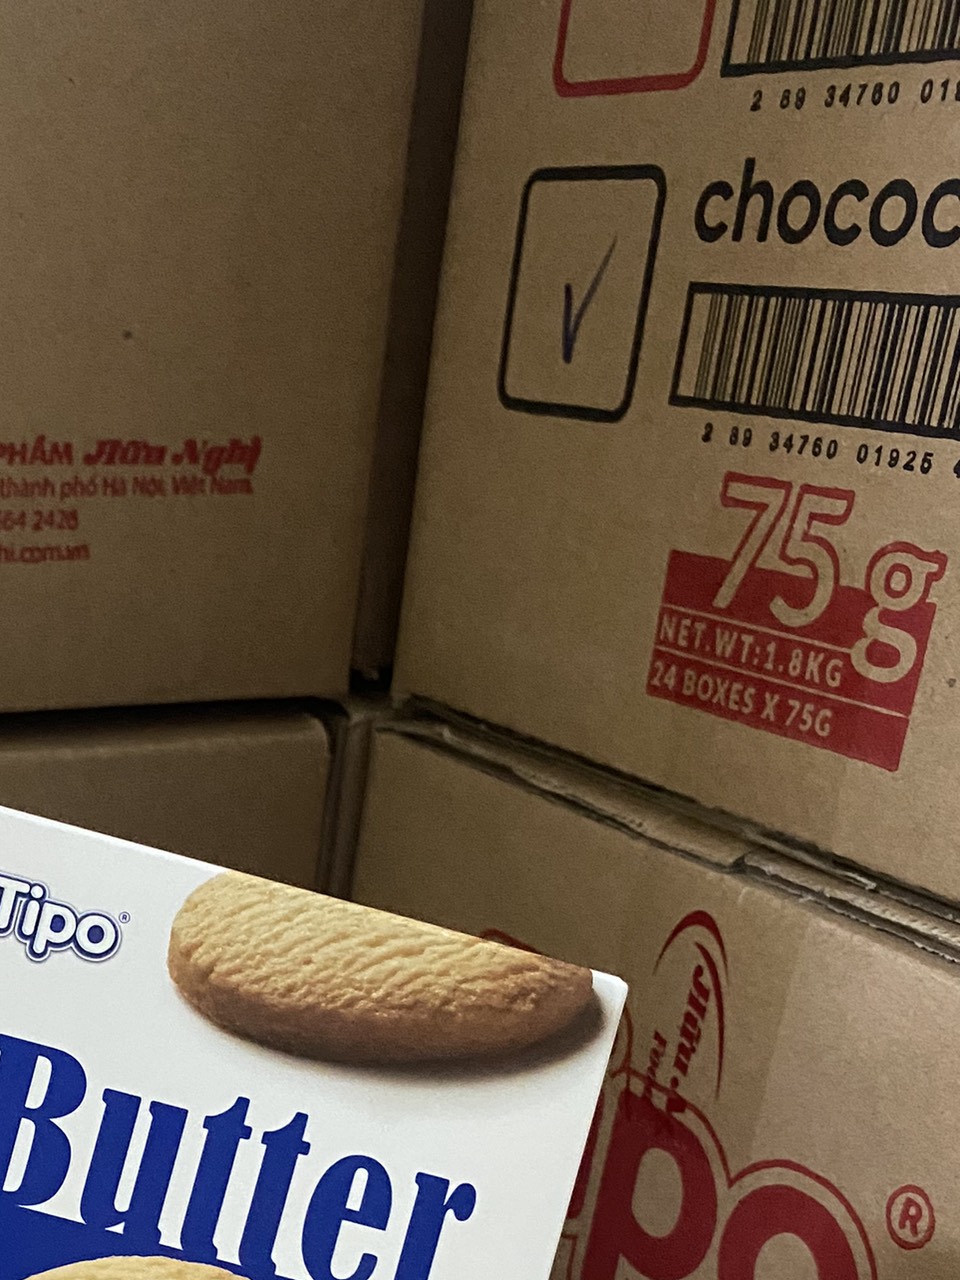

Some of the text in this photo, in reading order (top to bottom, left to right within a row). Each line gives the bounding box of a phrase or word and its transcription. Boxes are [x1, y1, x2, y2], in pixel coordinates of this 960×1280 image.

[769, 431, 838, 460] 34760
[649, 661, 833, 738] 24 BOXES X 75G
